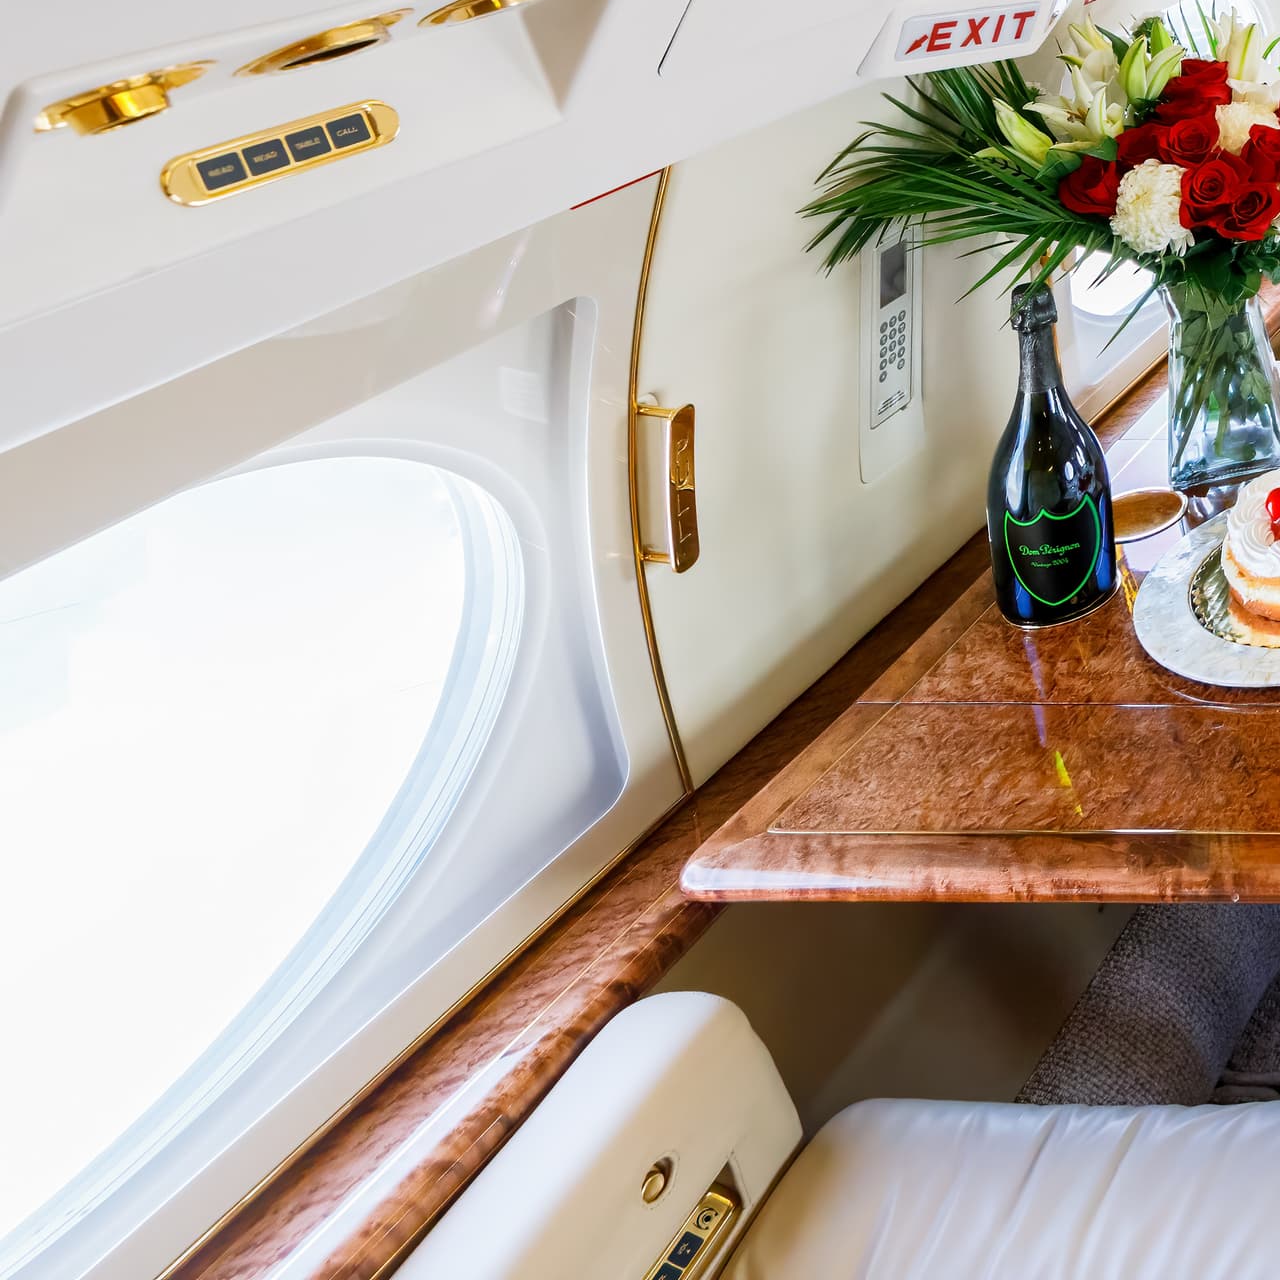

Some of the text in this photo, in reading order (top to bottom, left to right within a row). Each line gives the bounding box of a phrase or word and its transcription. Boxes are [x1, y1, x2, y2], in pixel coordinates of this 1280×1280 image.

[926, 10, 1036, 52] EXIT
[336, 126, 358, 137] CALL
[1019, 542, 1081, 557] Dom Pérignon
